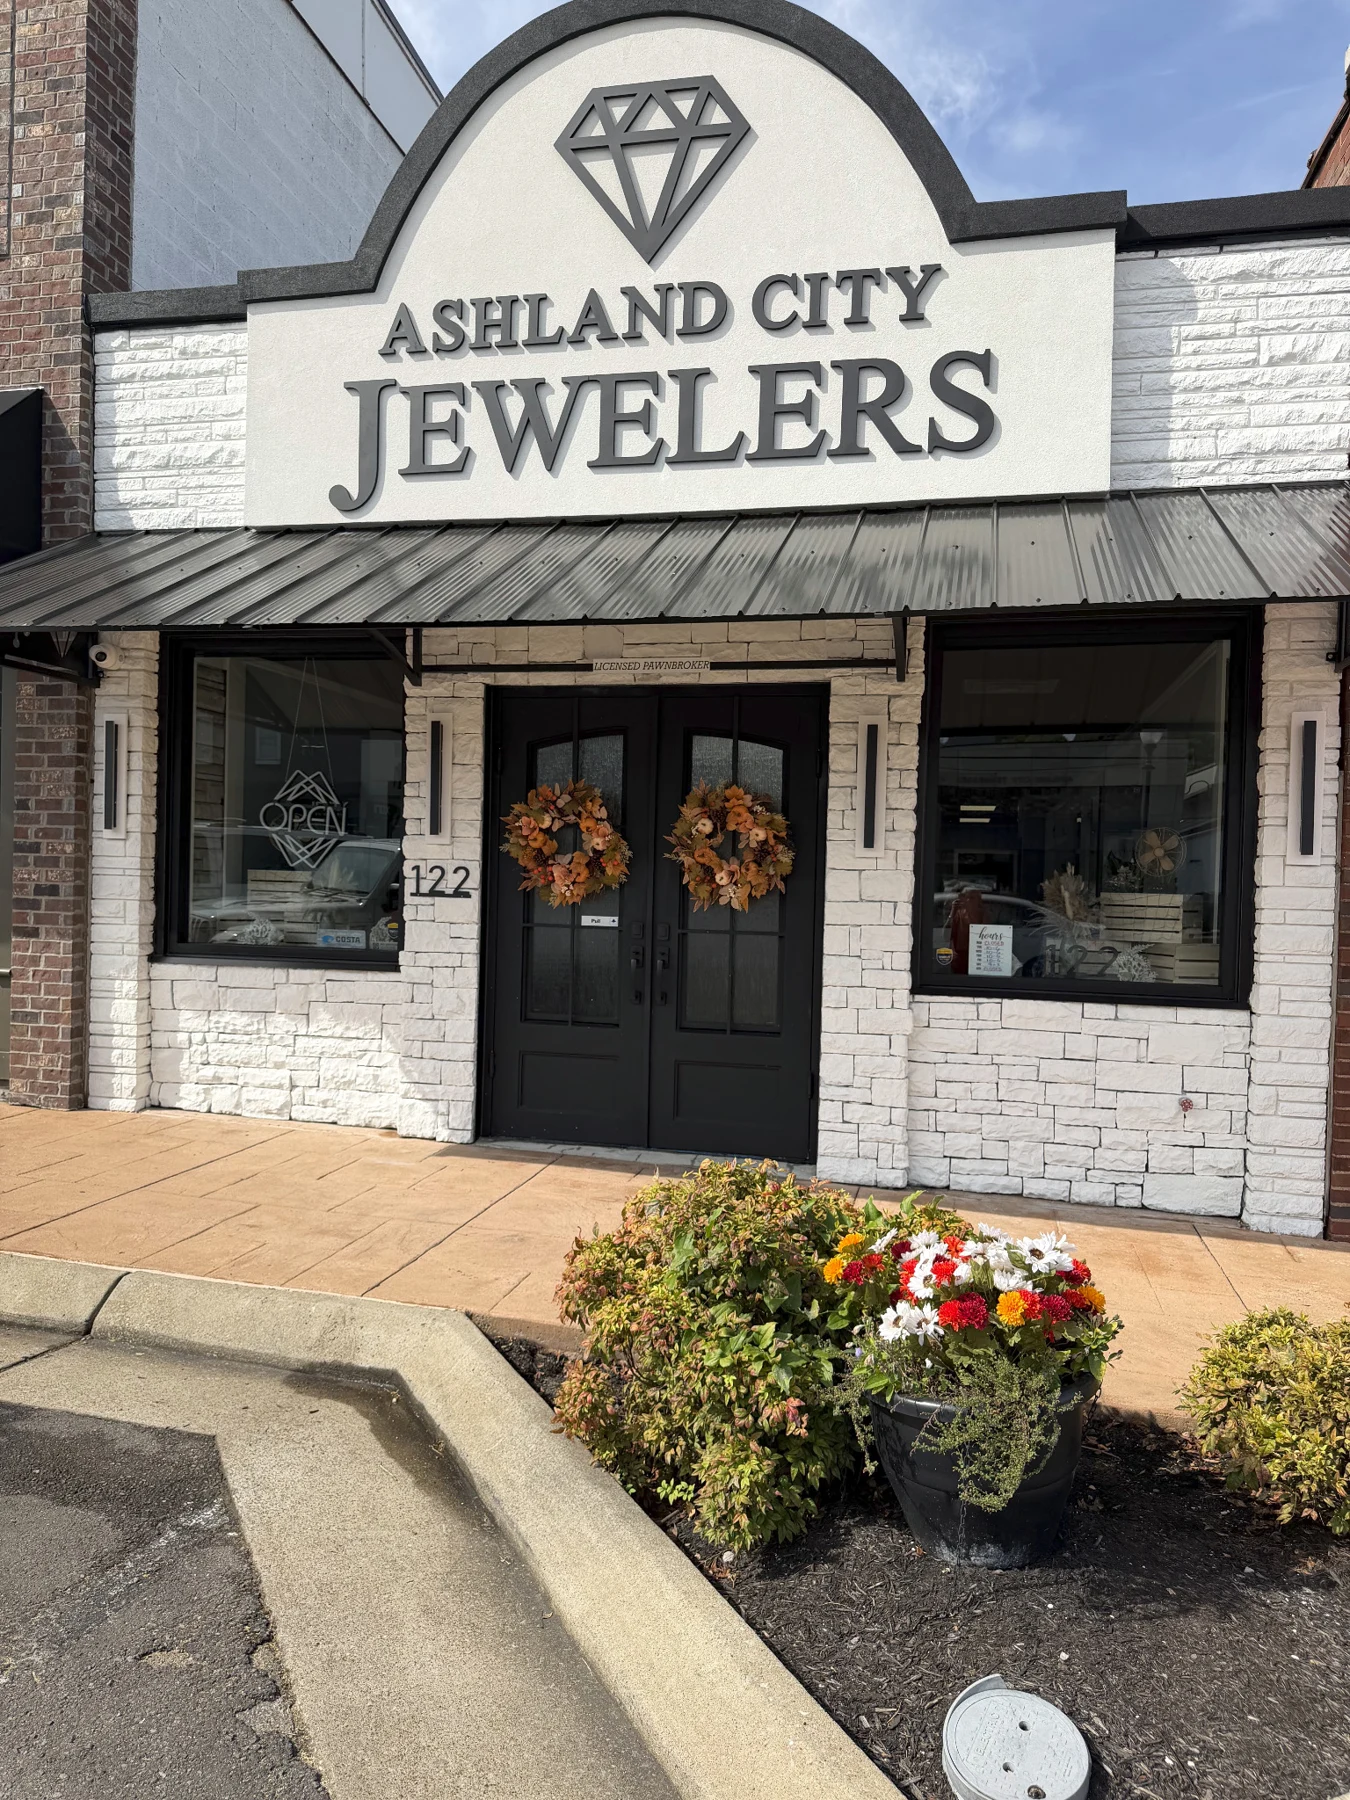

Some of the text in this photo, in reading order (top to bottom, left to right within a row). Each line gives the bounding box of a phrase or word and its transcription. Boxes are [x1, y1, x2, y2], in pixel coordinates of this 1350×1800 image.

[379, 263, 943, 356] ASHLAND CITY
[328, 348, 999, 512] JEWELERS
[594, 660, 710, 671] LICENSED PAWNBROKER
[259, 802, 347, 837] OPEN
[409, 864, 472, 898] 122
[335, 936, 361, 944] COSTA
[979, 926, 1003, 940] hours
